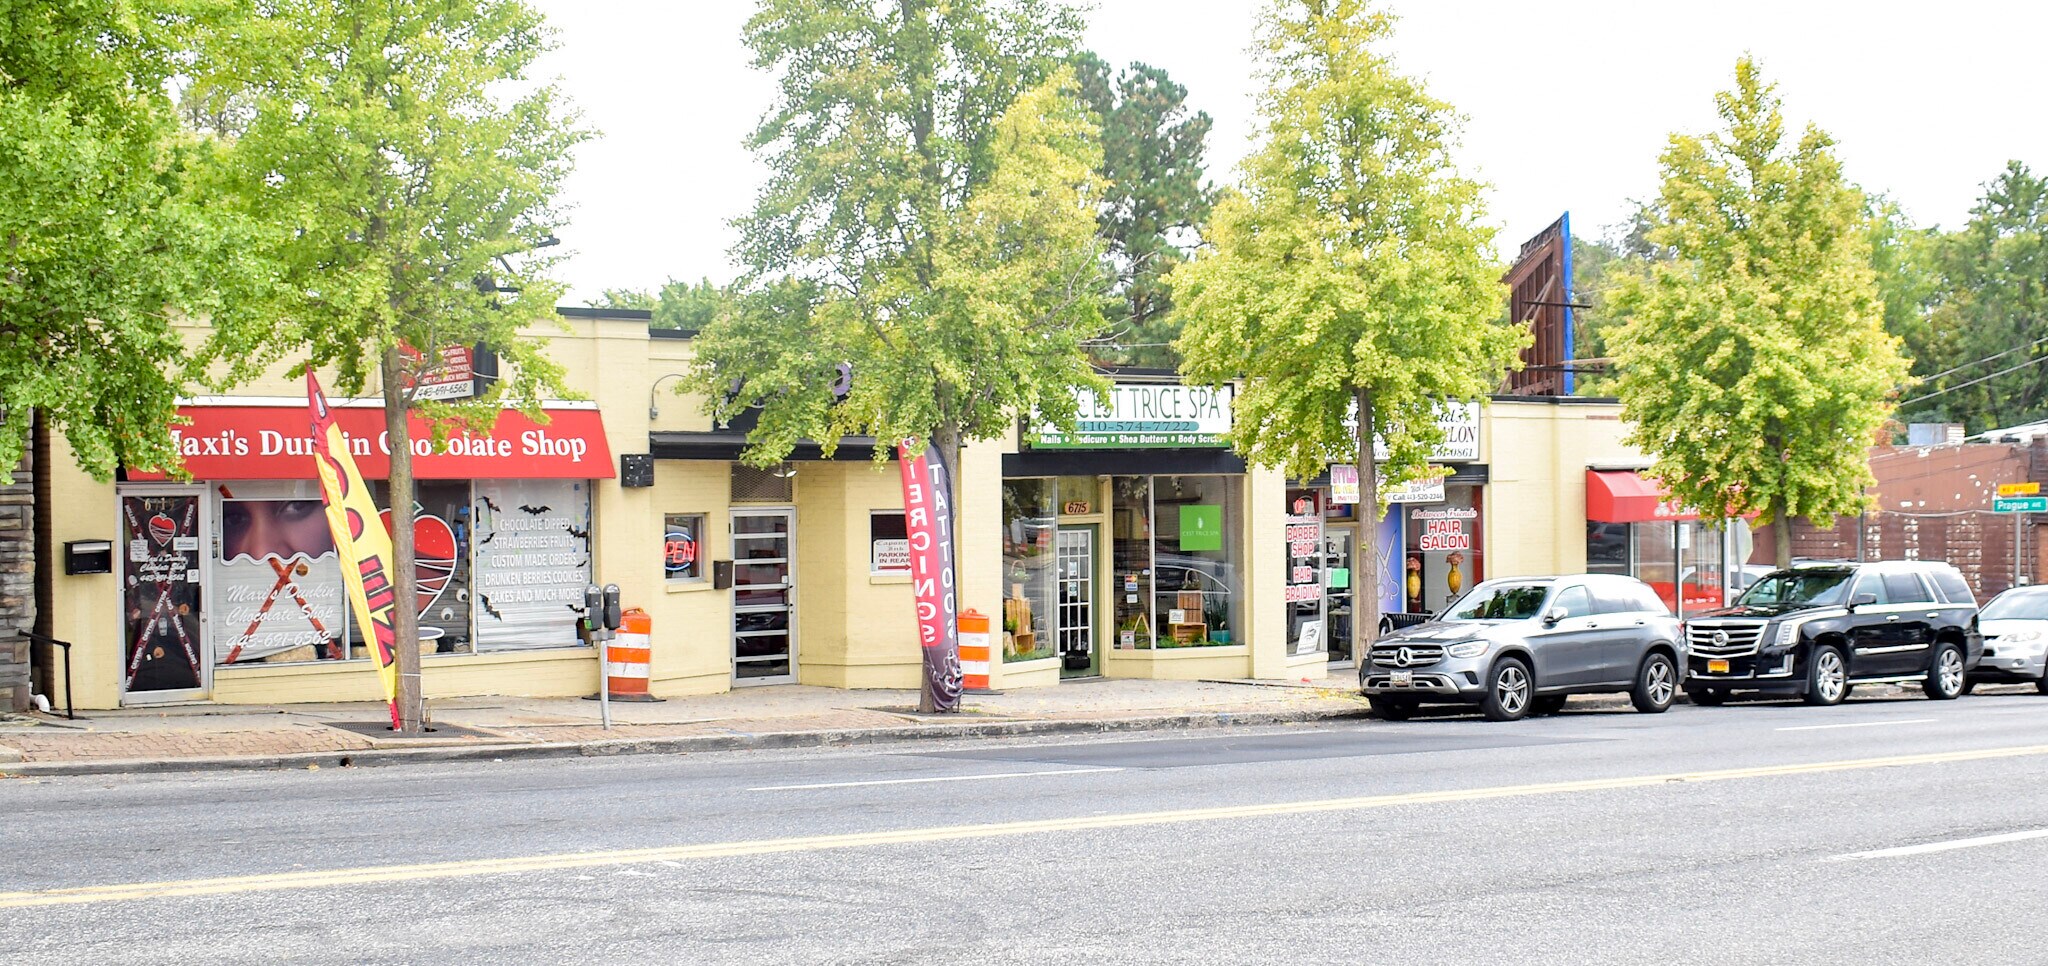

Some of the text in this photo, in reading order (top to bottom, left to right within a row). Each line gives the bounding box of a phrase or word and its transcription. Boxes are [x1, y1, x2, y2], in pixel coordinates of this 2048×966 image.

[1128, 387, 1182, 419] TRICE
[1189, 387, 1221, 419] SPA
[1079, 421, 1191, 432] 410-574-7722
[168, 430, 587, 462] Maxi's Dunin Coolate Shop
[1040, 434, 1062, 444] Nails
[1119, 434, 1138, 444] Shea
[1140, 434, 1168, 444] Butters
[1178, 434, 1196, 446] Body
[144, 497, 175, 511] 6719
[1068, 502, 1087, 513] 6715
[1997, 501, 2029, 511] Prague
[500, 518, 544, 531] CHOCOLATE
[1428, 520, 1461, 533] HAIR
[1287, 525, 1319, 541] BARBER
[494, 536, 549, 550] STRAWBERRIES
[1292, 542, 1315, 557] SHOP
[1422, 535, 1469, 549] SALON
[665, 541, 696, 564] PEN
[491, 555, 523, 568] CUSTOM
[525, 554, 547, 566] MADE
[485, 573, 521, 586] DRUNKEN
[523, 571, 552, 585] BERRIES
[1293, 567, 1312, 582] HAIR
[227, 582, 335, 602] Maxi's Dunkin
[488, 590, 514, 604] CAKES
[515, 589, 533, 602] AND
[535, 588, 557, 601] MUCH
[1286, 583, 1320, 600] BRAIDING
[226, 604, 333, 626] Chocolate Shop
[226, 630, 331, 649] 443-691-6562
